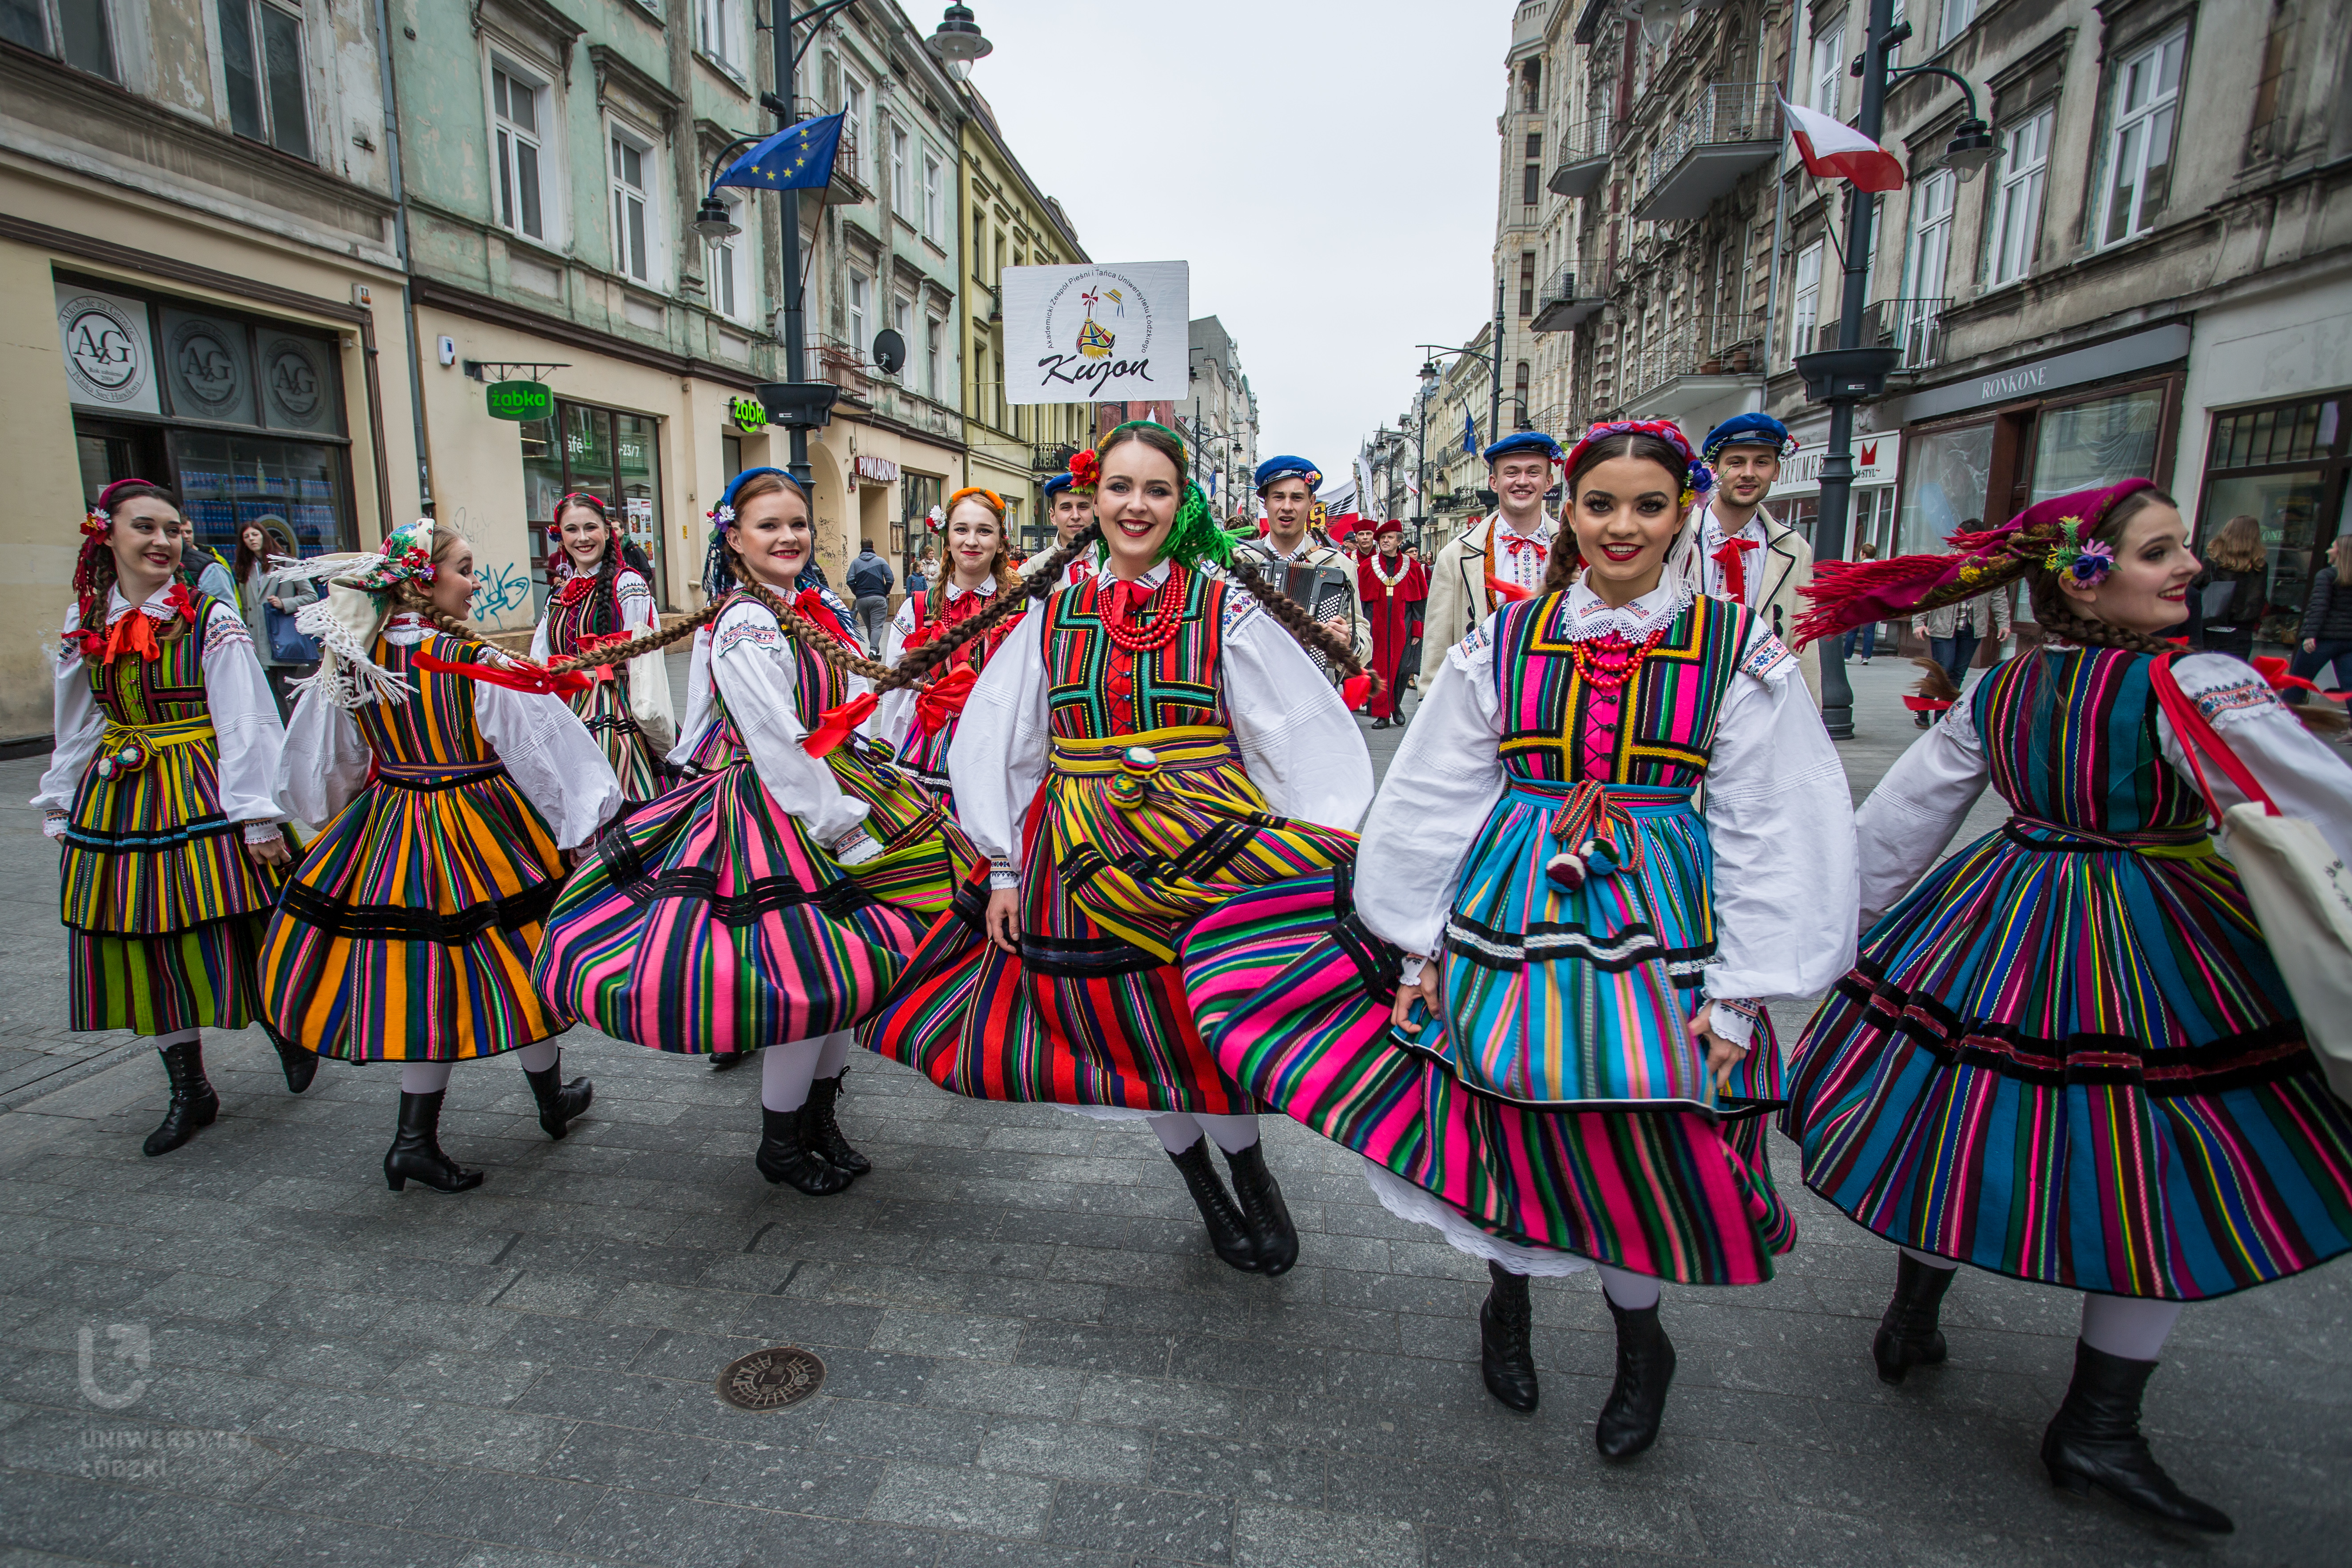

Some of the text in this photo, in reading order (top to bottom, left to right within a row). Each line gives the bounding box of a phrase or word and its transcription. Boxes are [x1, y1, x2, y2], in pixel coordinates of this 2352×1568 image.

[63, 298, 95, 323] Alkohole
[1045, 306, 1054, 349] Akademicki
[1050, 283, 1069, 305] Zespół
[1068, 271, 1090, 285] Pieśni
[1095, 269, 1116, 278] Tańca
[1118, 274, 1150, 313] Uniwersytetu
[1142, 315, 1153, 353] Łódzkiego
[72, 371, 94, 394] Polska
[111, 381, 141, 400] Handlowa
[1038, 351, 1154, 397] Kujon
[1982, 367, 2047, 399] RONKONE
[491, 390, 545, 407] żabka
[618, 444, 639, 457] -23/7
[859, 457, 898, 480] PIWIARNIA
[1777, 453, 1825, 486] ERFUMER
